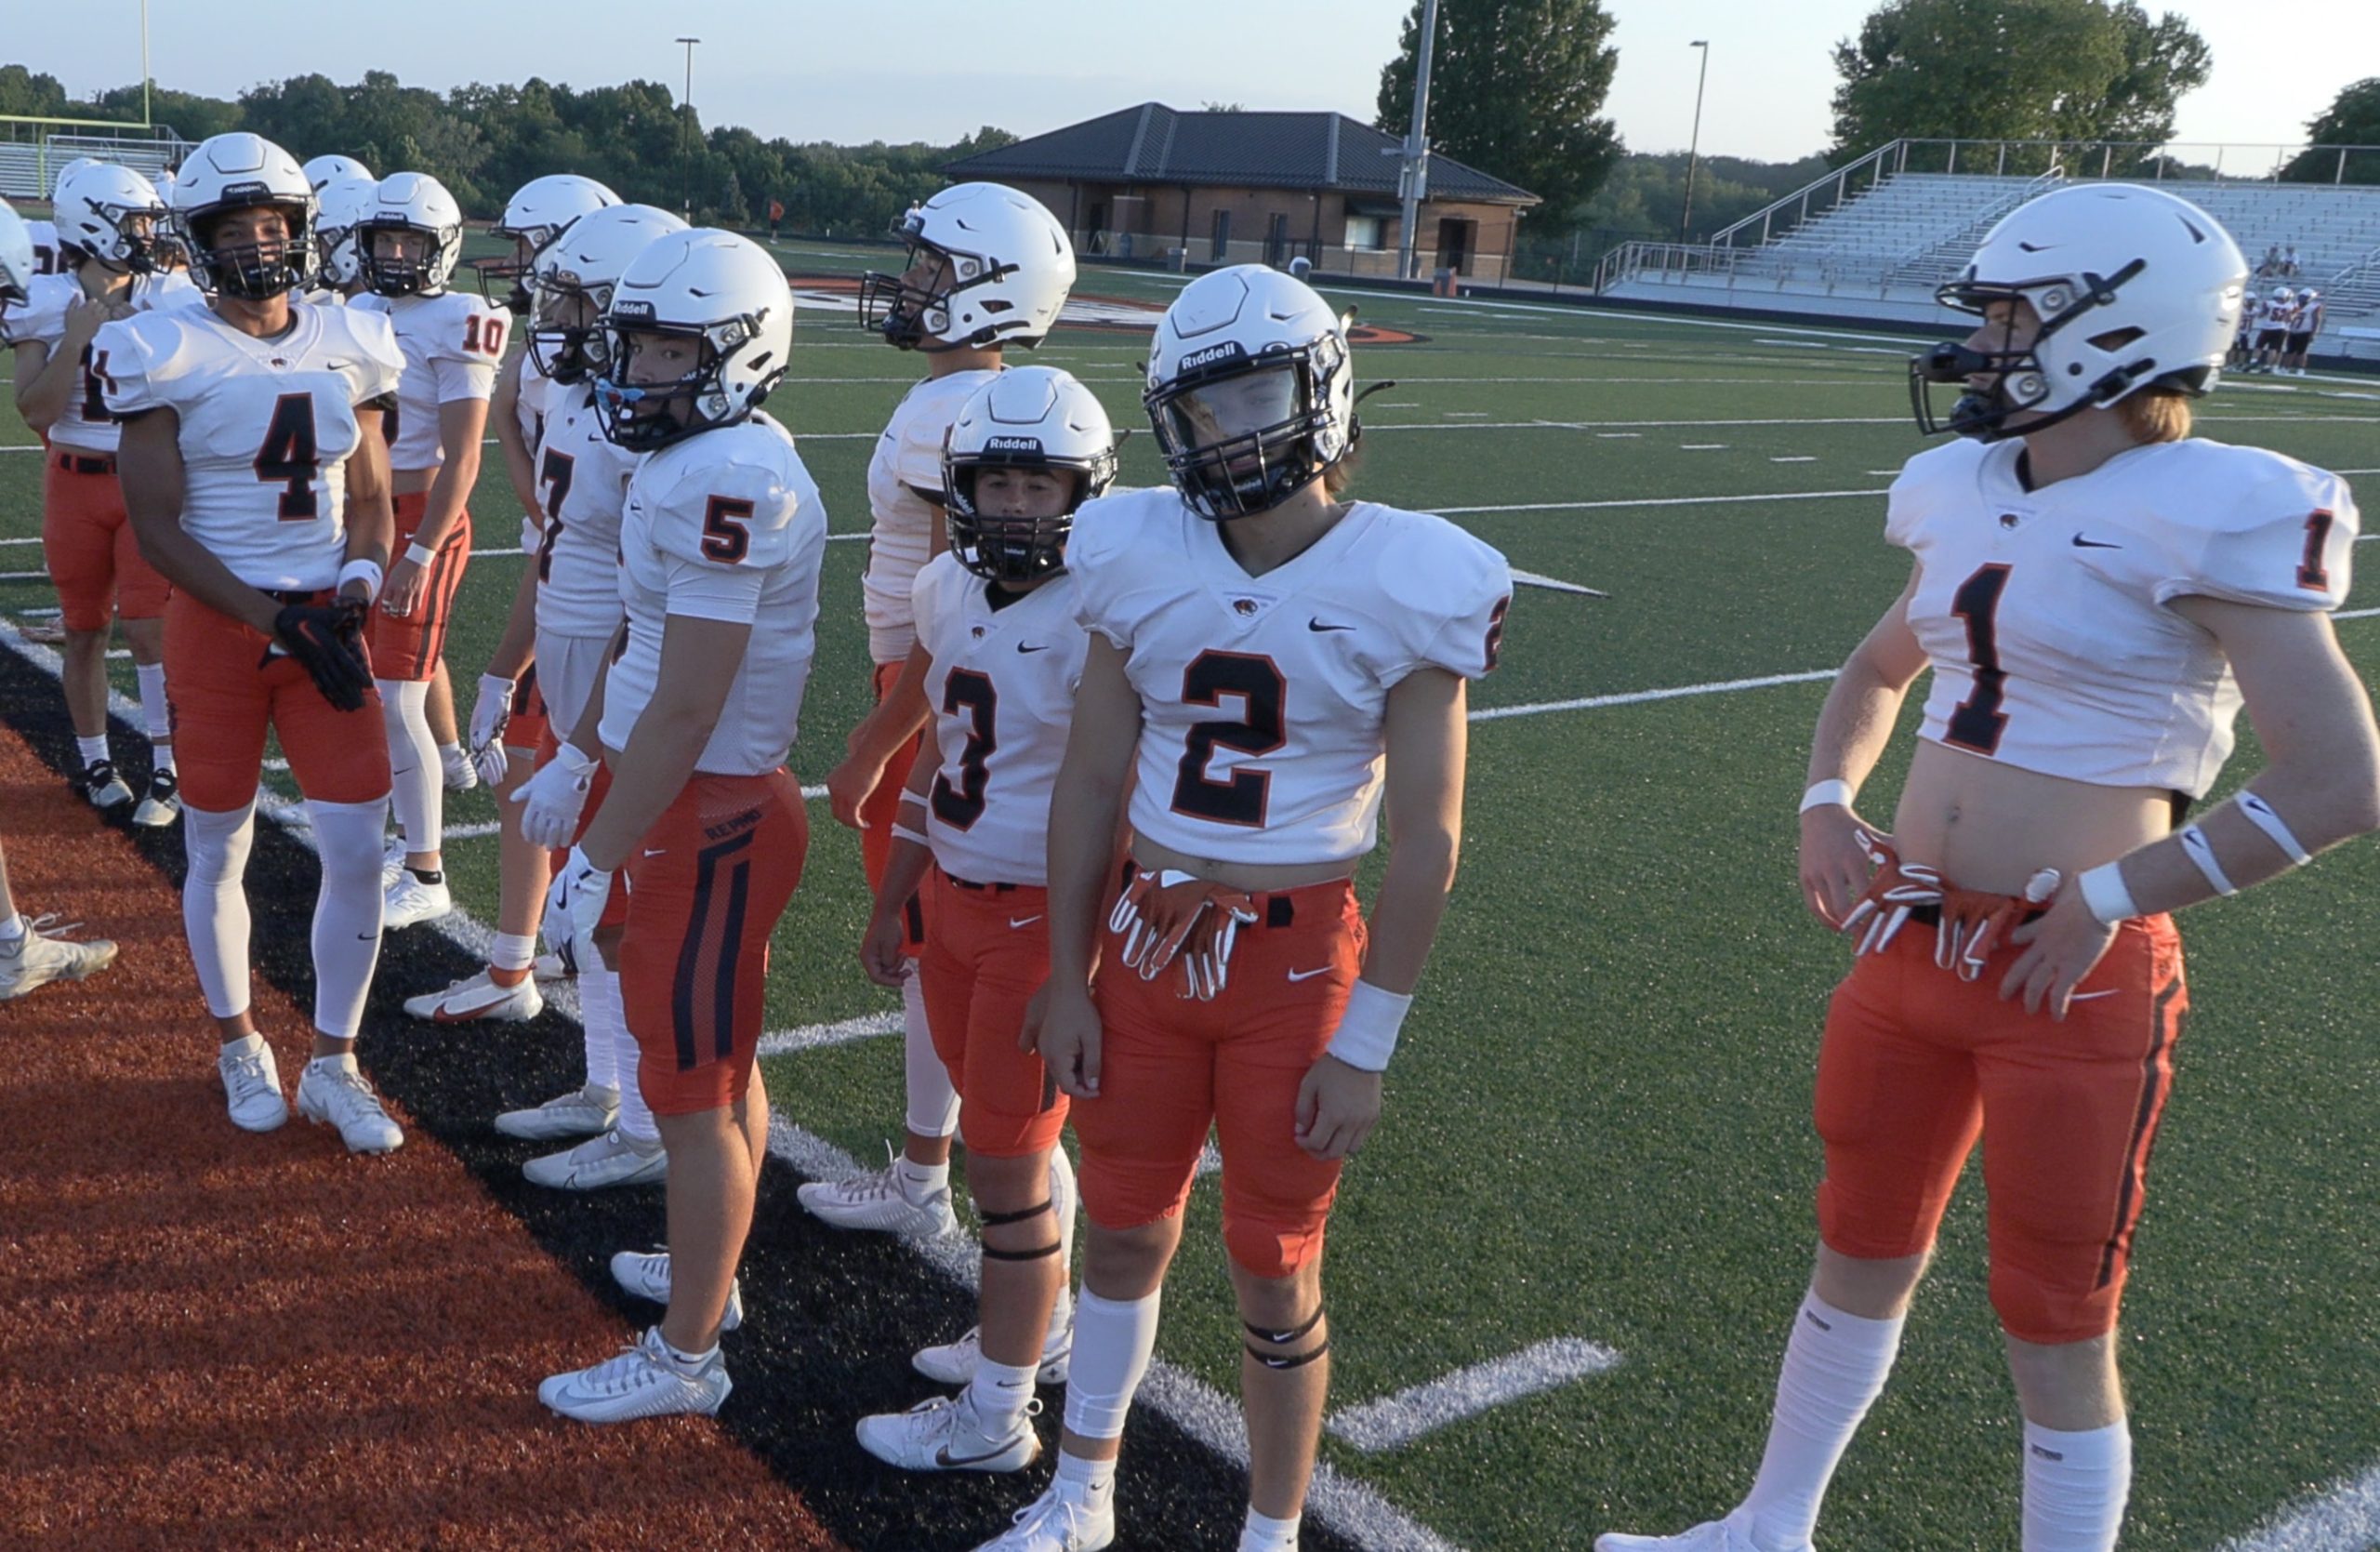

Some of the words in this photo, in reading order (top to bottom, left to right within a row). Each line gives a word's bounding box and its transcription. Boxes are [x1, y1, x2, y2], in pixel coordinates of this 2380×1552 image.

[462, 314, 504, 357] 10
[614, 302, 649, 314] Riddell
[1182, 342, 1236, 370] Riddell
[254, 392, 321, 521] 4
[989, 439, 1038, 450] Riddell
[539, 445, 575, 585] 7
[700, 495, 755, 564] 5
[2296, 508, 2333, 592] 1
[1941, 563, 2013, 756] 1
[930, 666, 997, 832] 3
[1170, 648, 1287, 829] 2
